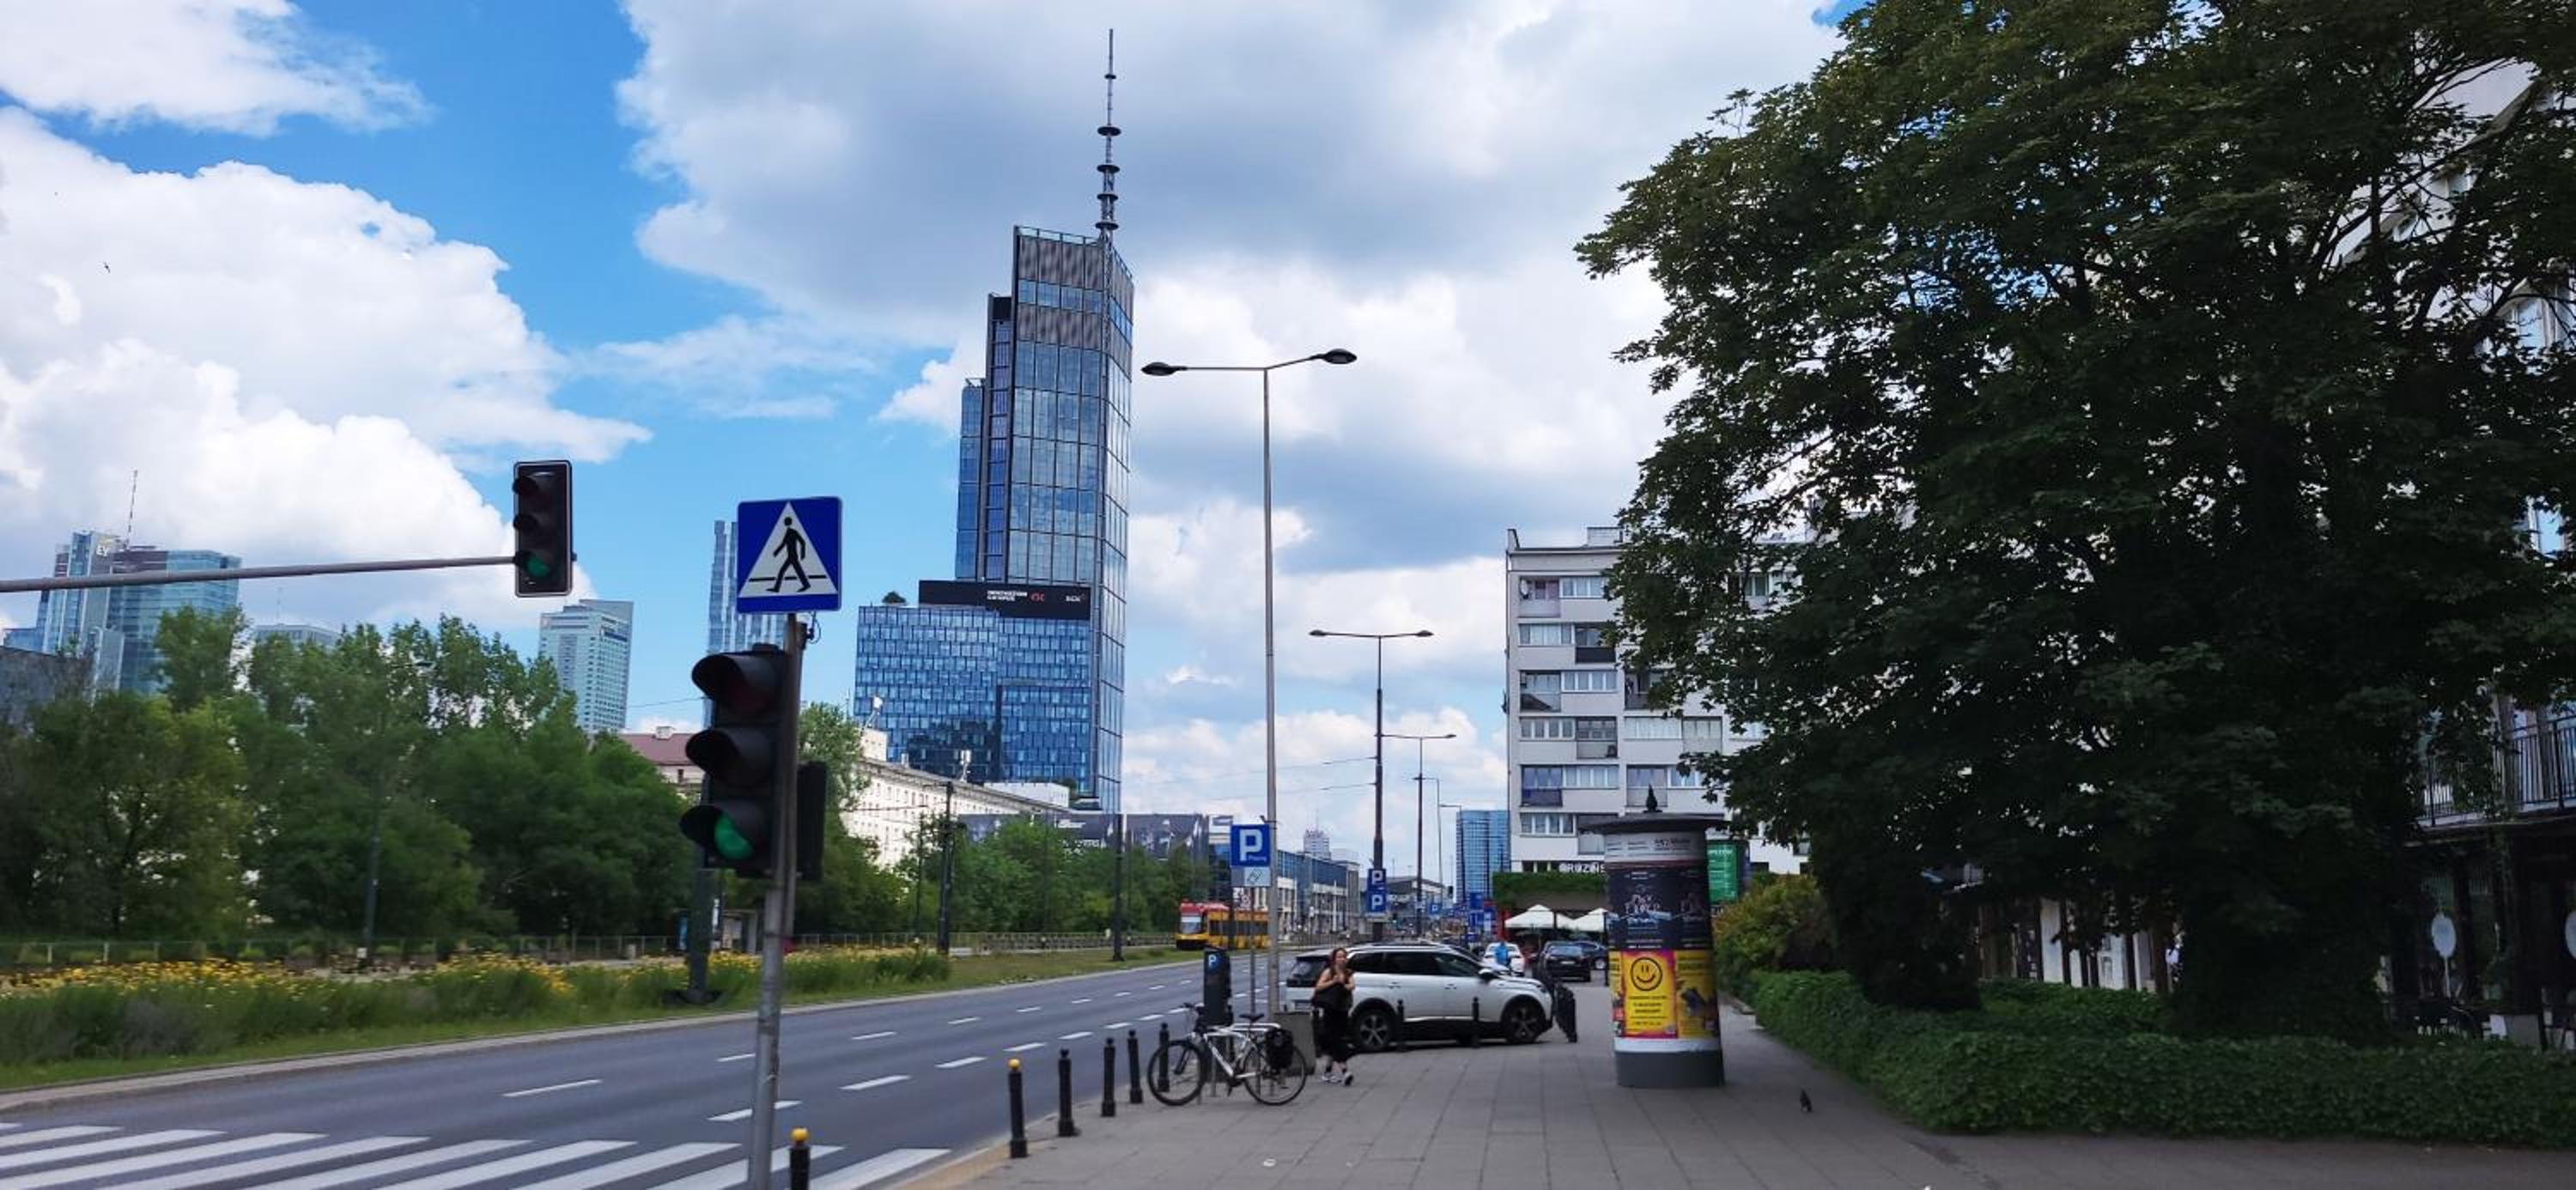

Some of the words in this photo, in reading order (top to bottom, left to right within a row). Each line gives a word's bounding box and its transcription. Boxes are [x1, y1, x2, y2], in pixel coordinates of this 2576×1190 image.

[96, 543, 110, 556] EY
[1239, 829, 1263, 861] P
[1371, 870, 1383, 884] P
[1371, 894, 1383, 910] P
[1208, 954, 1217, 968] P
